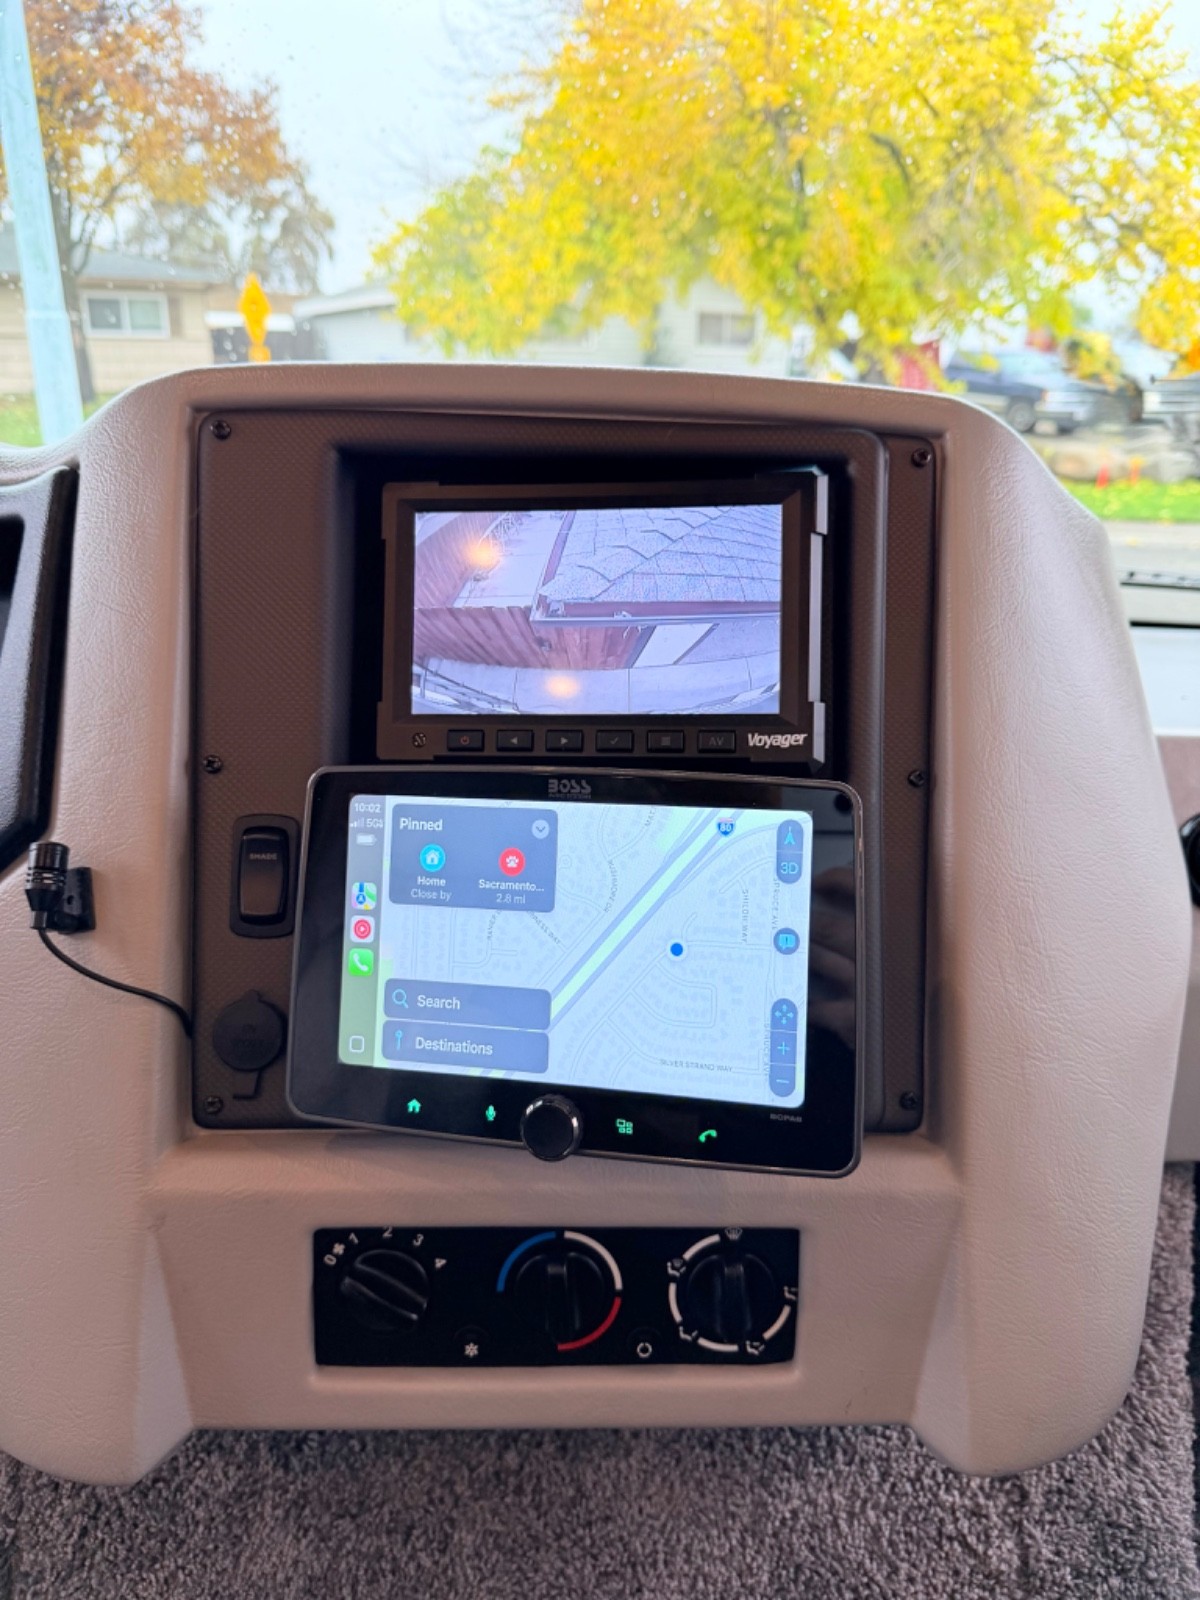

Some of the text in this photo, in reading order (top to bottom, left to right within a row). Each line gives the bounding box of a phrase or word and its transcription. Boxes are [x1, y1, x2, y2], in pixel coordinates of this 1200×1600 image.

[709, 736, 725, 746] AV
[747, 733, 808, 749] Voyager
[548, 779, 592, 794] BOSS
[354, 803, 382, 814] 10:02
[399, 818, 443, 832] Pinned
[780, 862, 799, 875] 3D
[417, 876, 446, 888] Home
[478, 879, 545, 893] Sacramento...
[411, 889, 452, 902] Close by
[496, 893, 526, 905] 2.8 mi
[417, 994, 461, 1010] Search
[415, 1036, 493, 1056] Destinations
[348, 1232, 359, 1244] 1
[382, 1226, 393, 1239] 2
[412, 1233, 424, 1247] 3
[434, 1258, 447, 1269] 4
